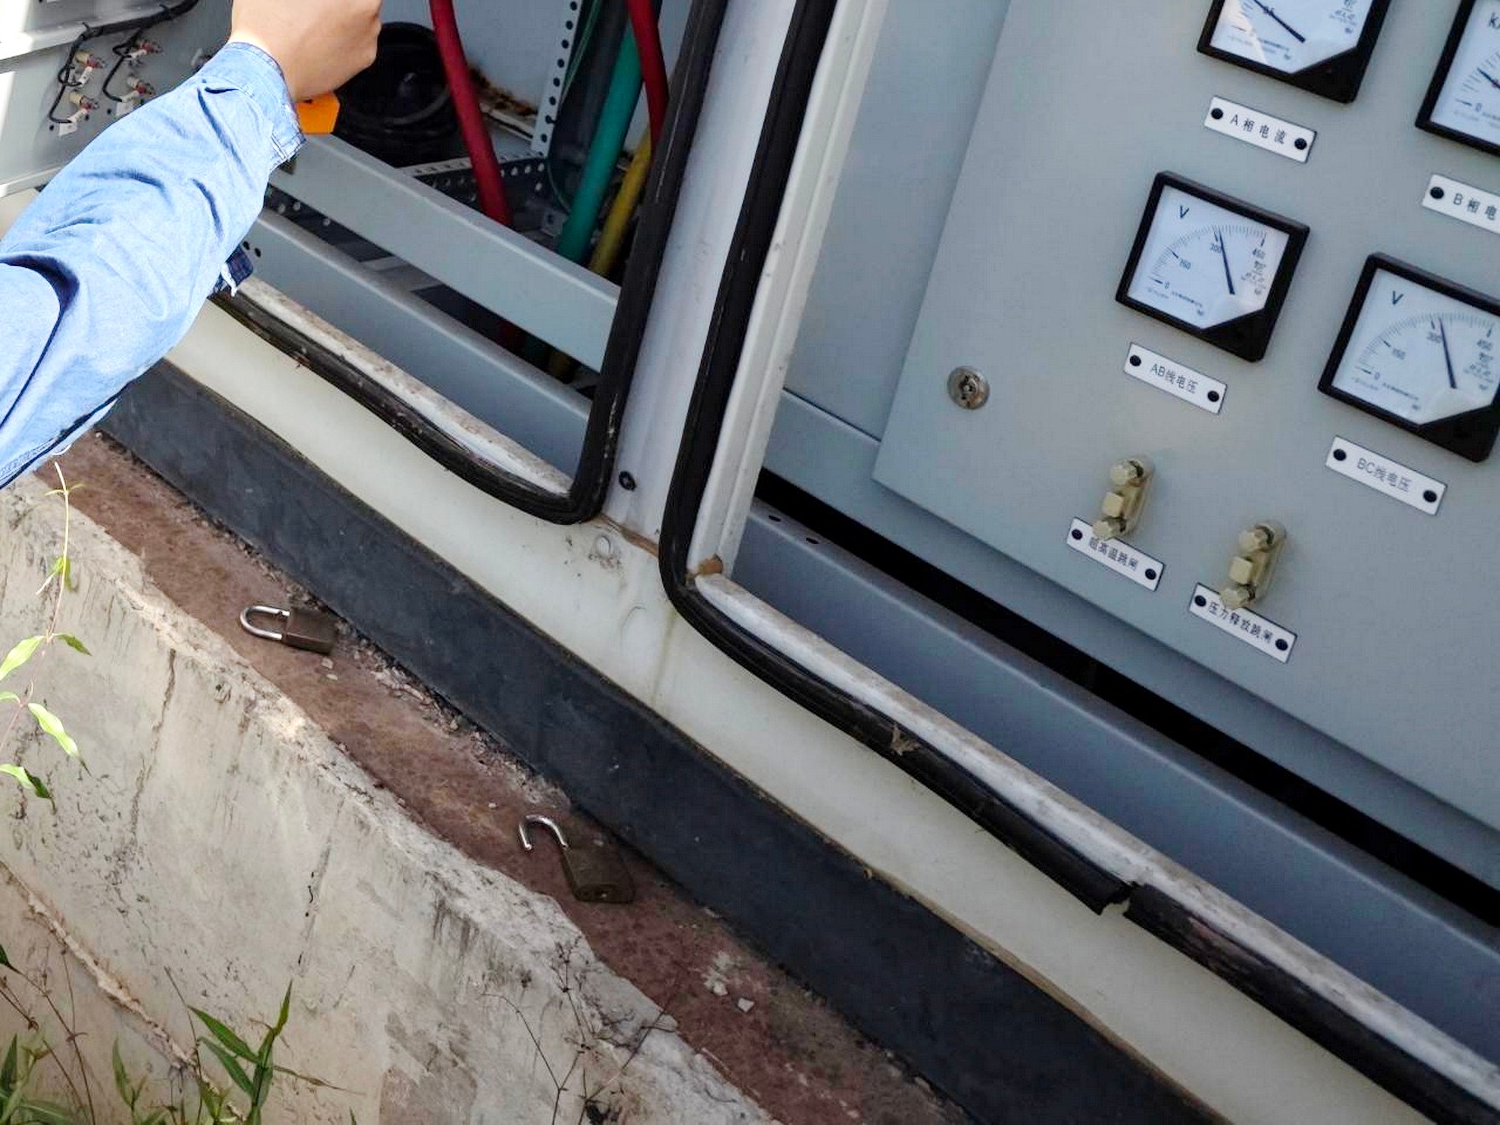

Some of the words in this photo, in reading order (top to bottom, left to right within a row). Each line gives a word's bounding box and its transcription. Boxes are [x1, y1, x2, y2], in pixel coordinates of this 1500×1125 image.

[1488, 11, 1500, 30] k
[1230, 114, 1287, 144] A相电流
[1179, 205, 1190, 219] V
[1392, 290, 1404, 305] V
[1150, 363, 1199, 394] AB线电压
[1356, 457, 1413, 493] BC线电压
